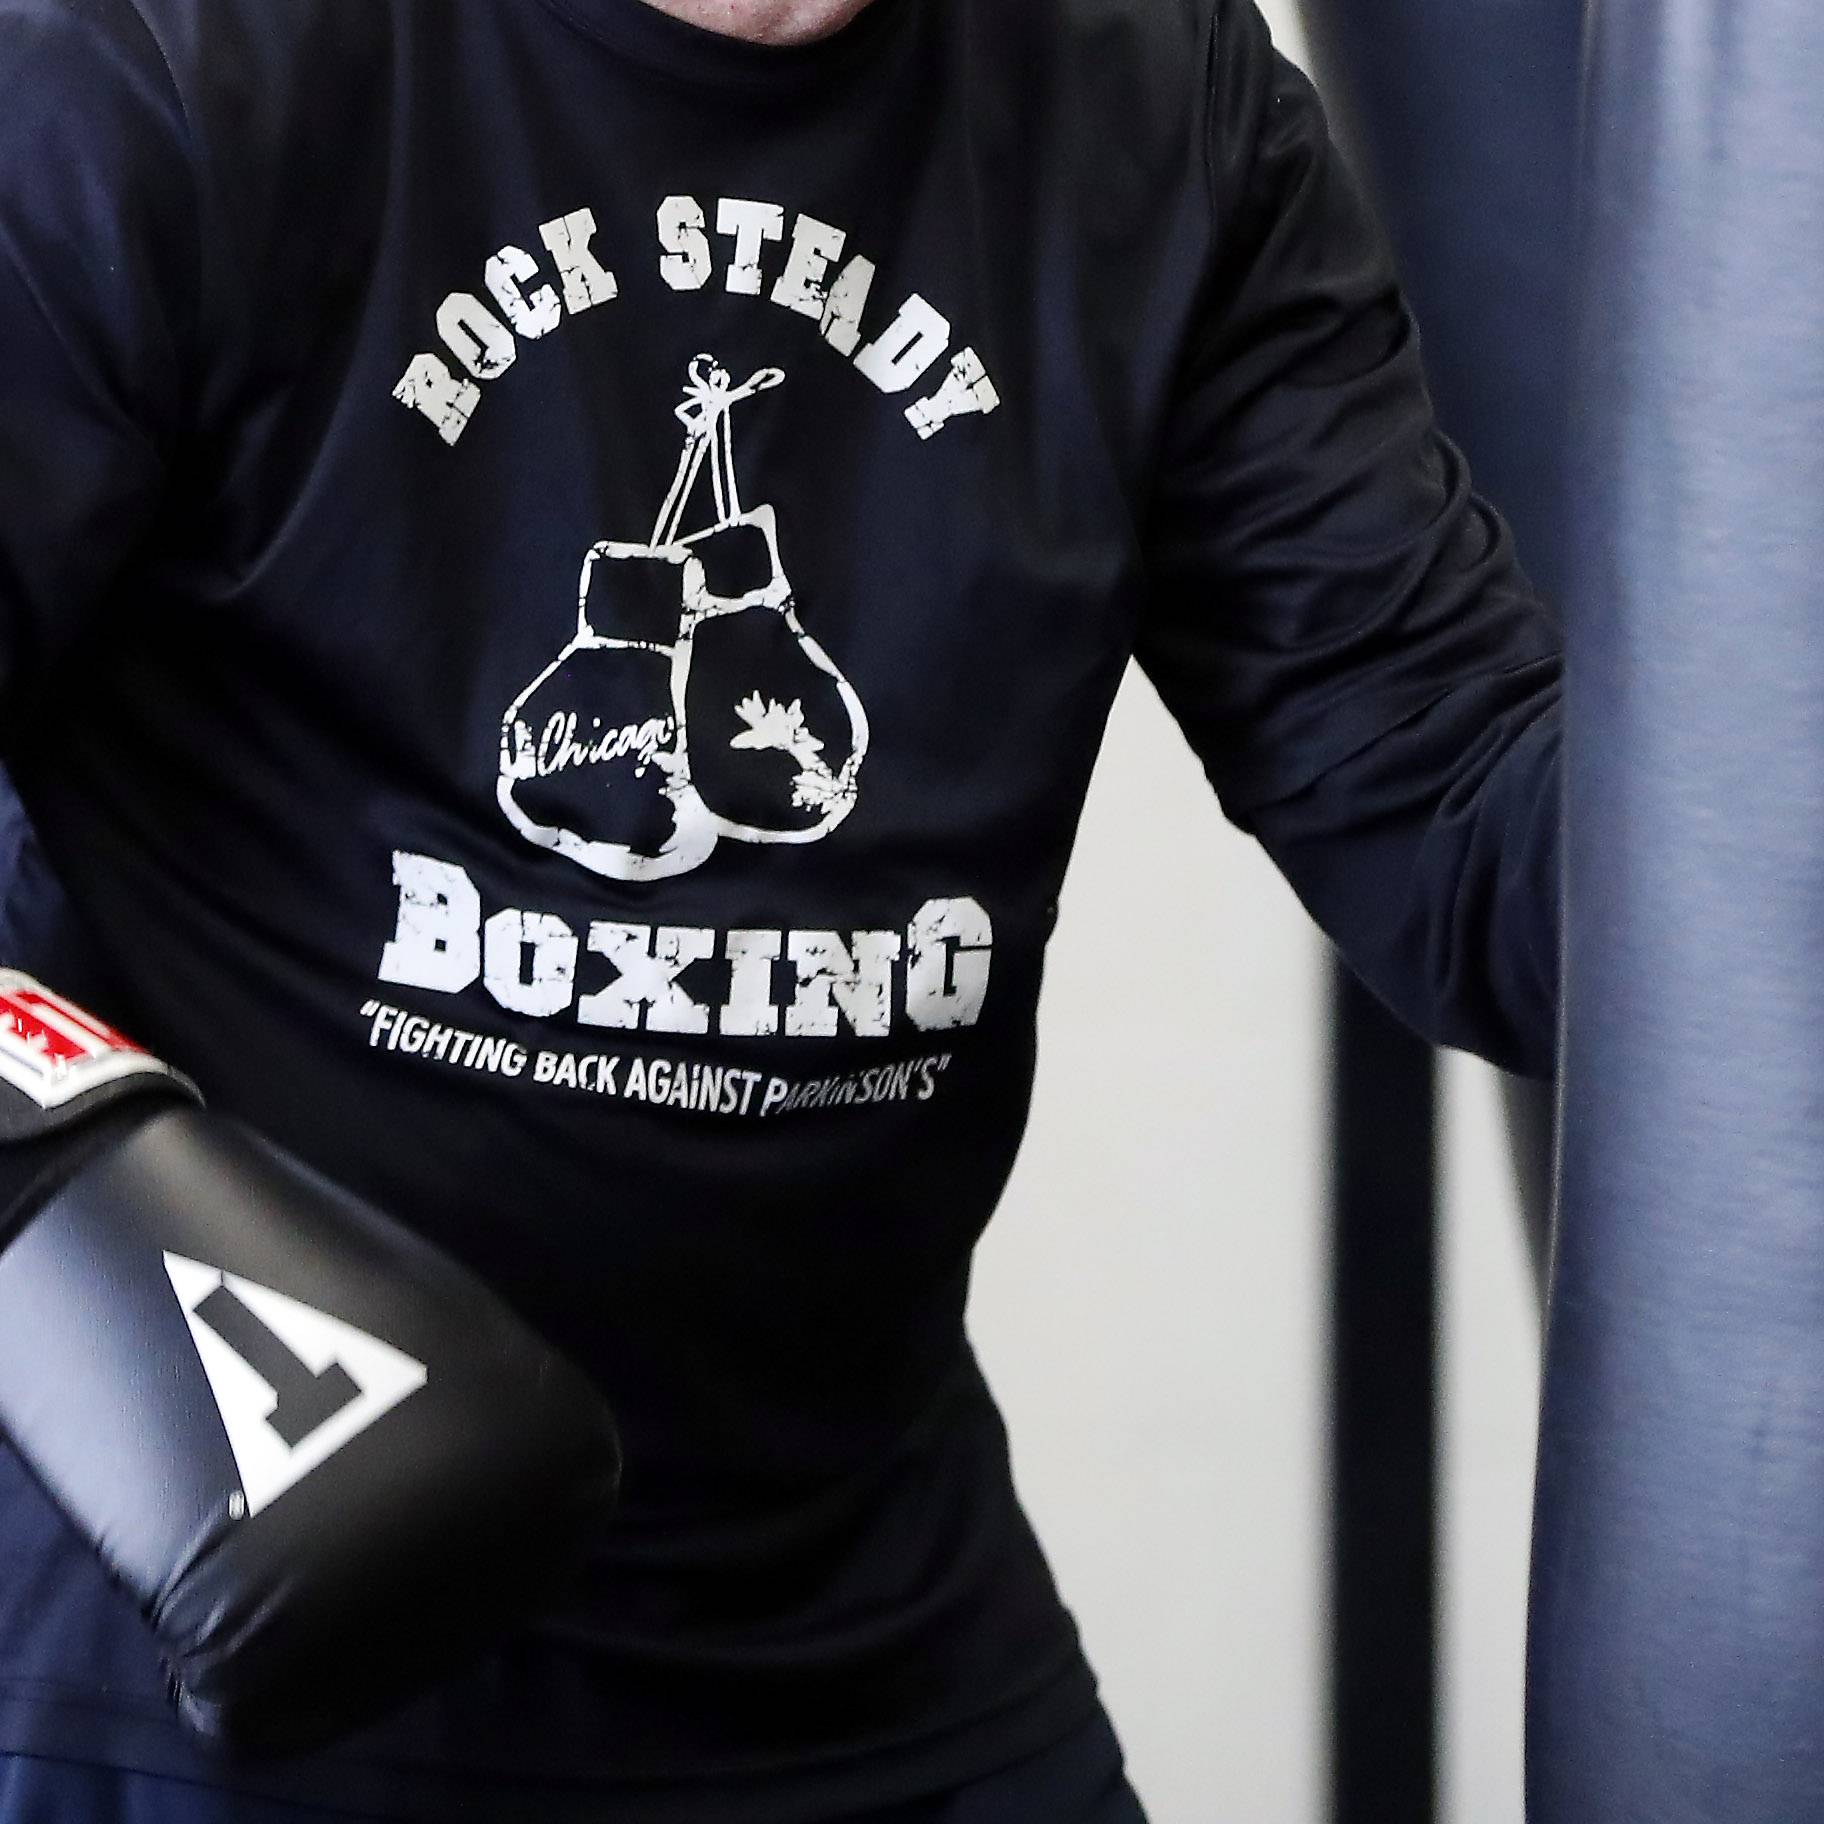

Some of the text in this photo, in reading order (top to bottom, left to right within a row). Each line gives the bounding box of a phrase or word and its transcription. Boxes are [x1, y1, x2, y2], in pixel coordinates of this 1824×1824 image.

[392, 195, 1000, 446] ROCK STEADY
[537, 710, 674, 778] Chicago
[377, 850, 994, 1037] BOXING
[533, 1050, 620, 1095] BACK
[192, 1283, 364, 1450] T
